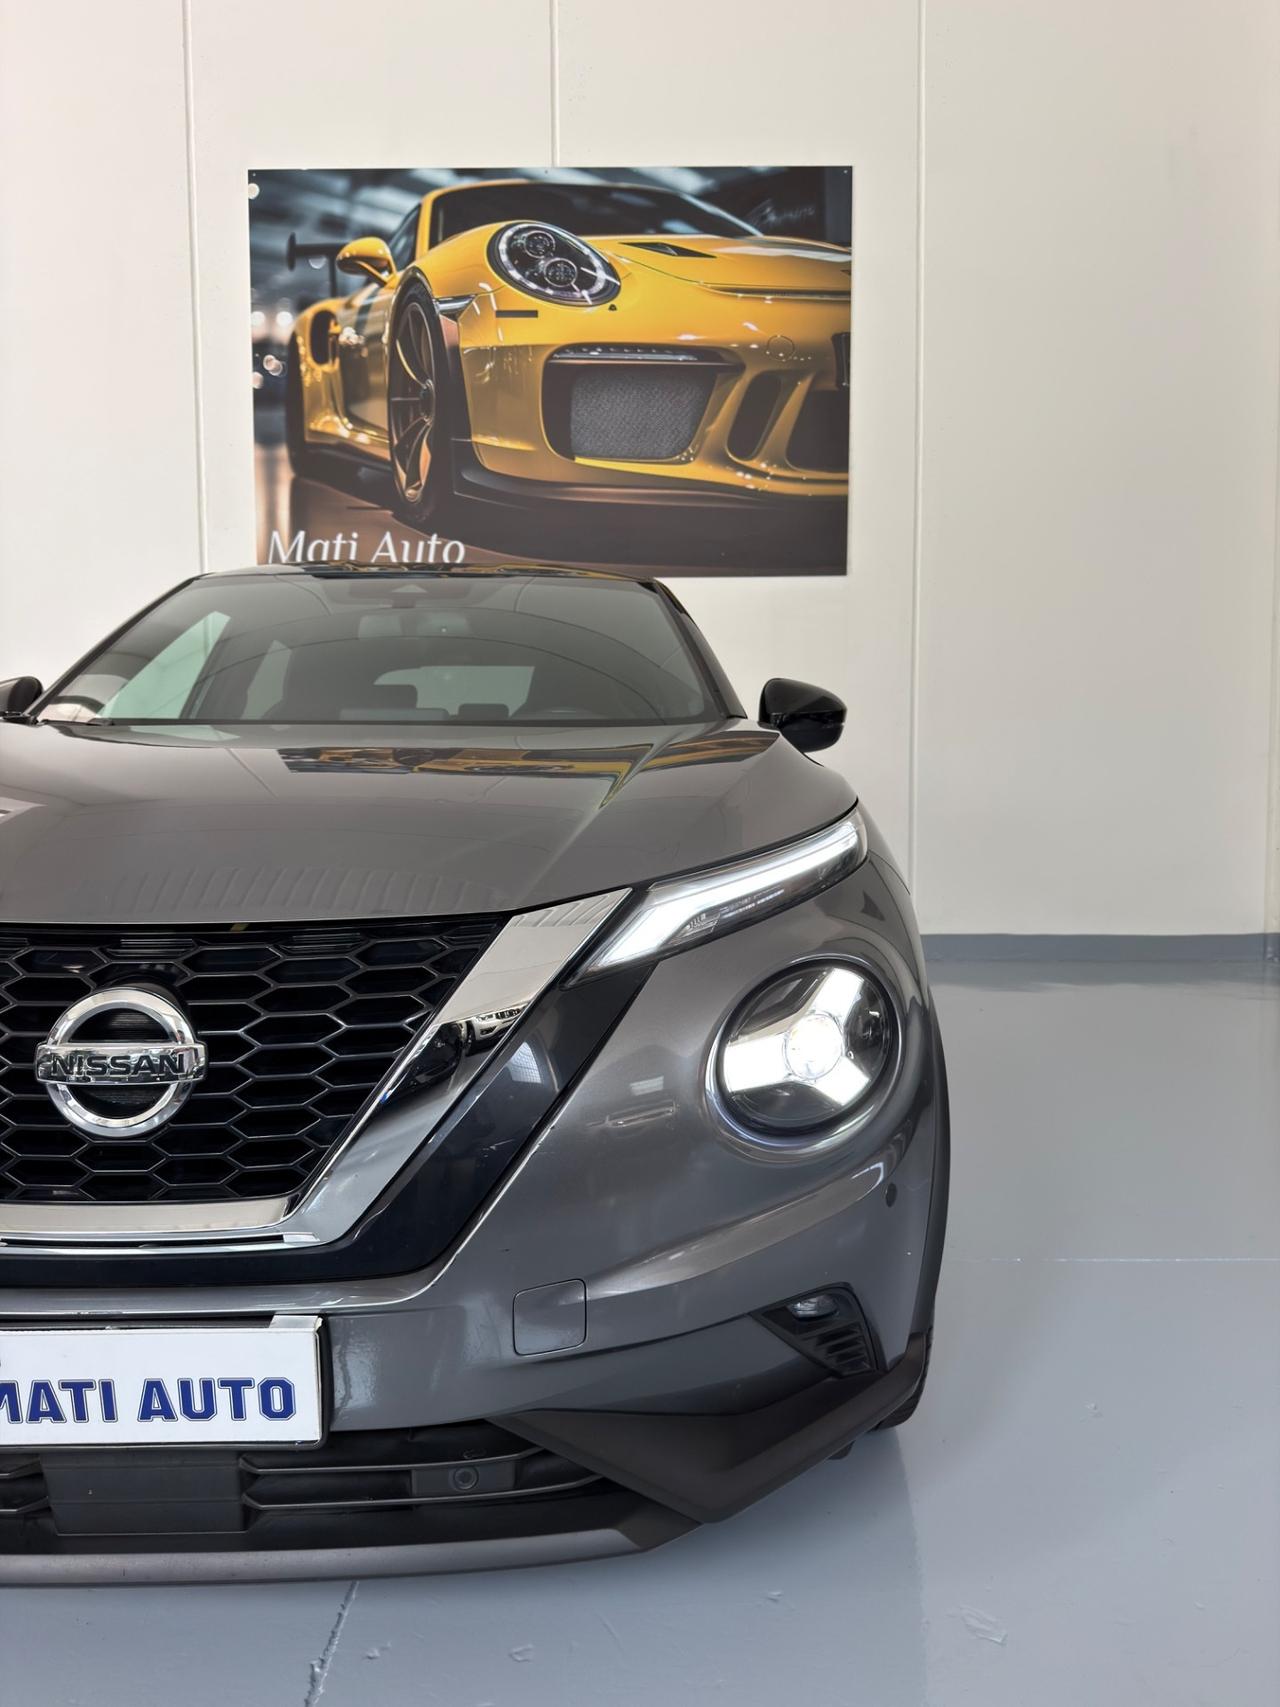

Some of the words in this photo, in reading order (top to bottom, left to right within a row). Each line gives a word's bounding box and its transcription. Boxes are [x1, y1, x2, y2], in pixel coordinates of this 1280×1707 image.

[268, 530, 359, 564] Mati
[371, 531, 466, 563] Auto
[50, 1053, 186, 1076] NISSAN
[137, 1377, 297, 1422] AUTO
